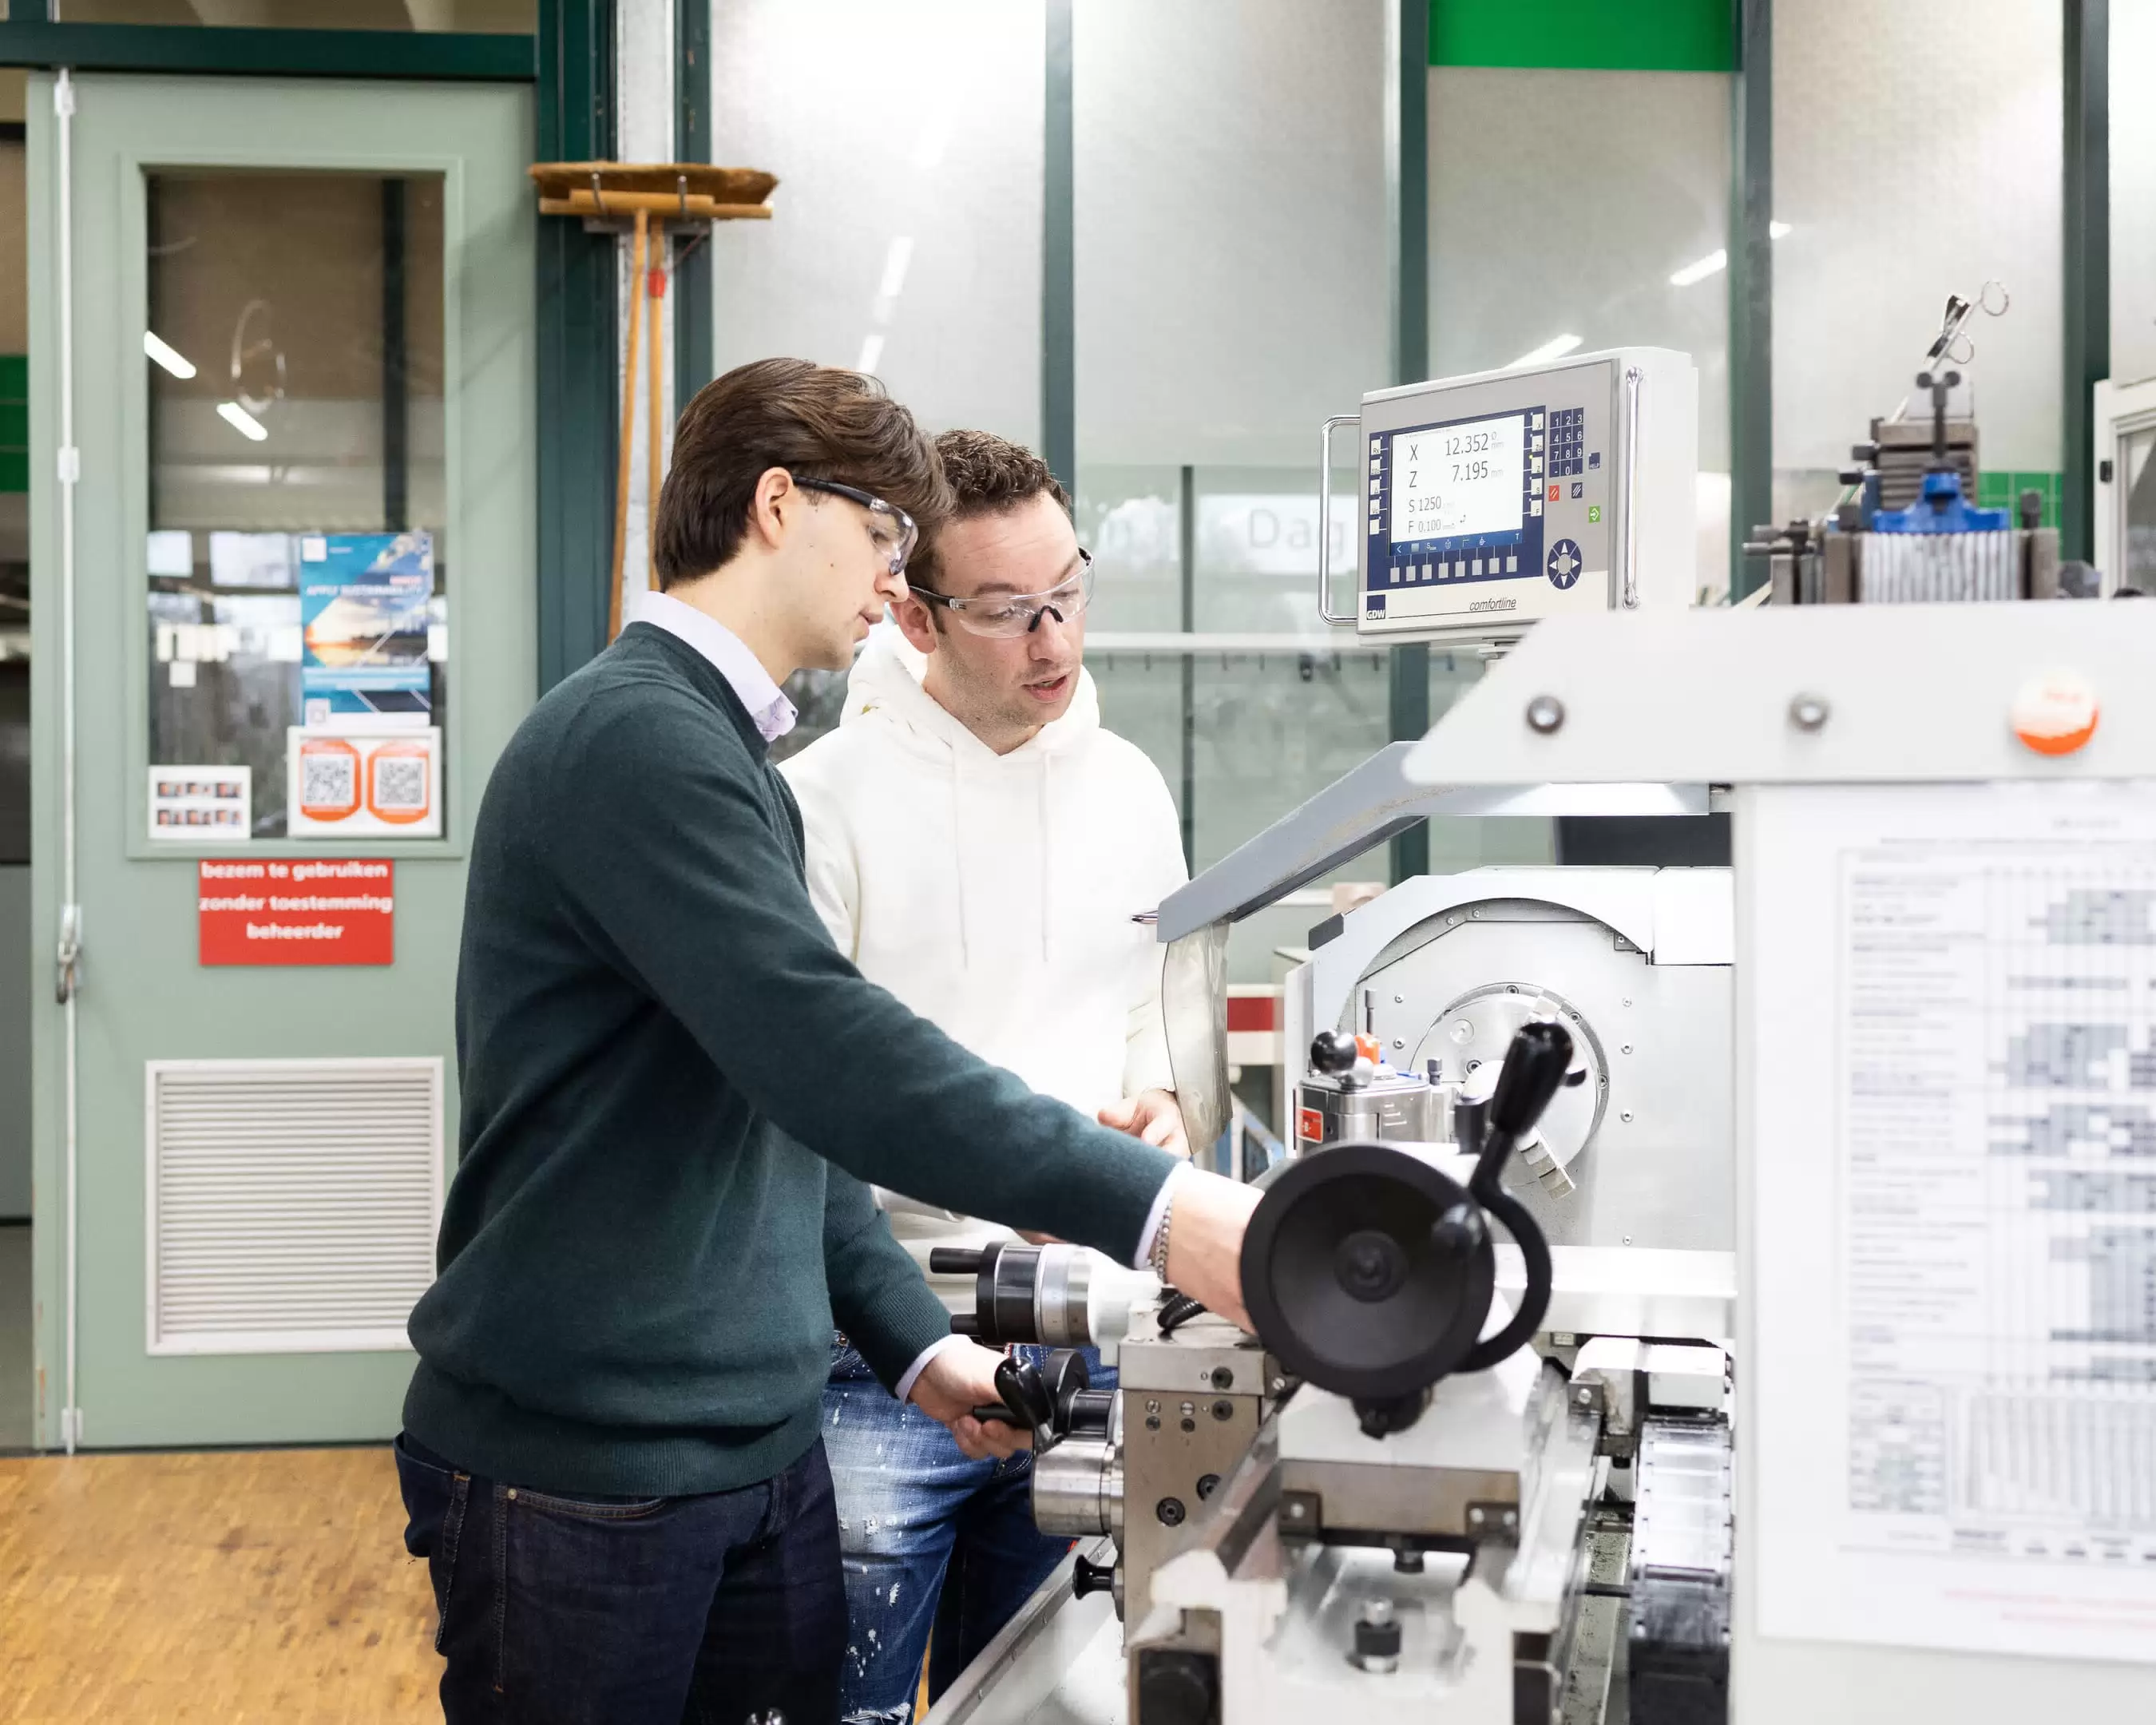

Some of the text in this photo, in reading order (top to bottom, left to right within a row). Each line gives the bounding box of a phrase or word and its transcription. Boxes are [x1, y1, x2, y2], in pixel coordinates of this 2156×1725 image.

[1555, 414, 1583, 426] 1 2 3
[1566, 433, 1571, 442] 5
[1577, 431, 1582, 440] 6
[1409, 444, 1418, 462] X
[1445, 433, 1488, 456] 12.352
[1554, 448, 1582, 460] 7 8 9
[1409, 470, 1417, 488] Z
[1453, 461, 1488, 482] 7.195
[1565, 466, 1570, 475] 0
[1409, 499, 1415, 513] S
[1418, 496, 1441, 512] 1250
[1408, 521, 1414, 533] F
[1418, 519, 1441, 533] 0.100
[1469, 597, 1516, 611] comfortline
[1367, 609, 1385, 619] GDW
[200, 861, 388, 882] bezem te gebruiken
[199, 894, 393, 914] zonder toestemming
[246, 922, 344, 939] beheerder
